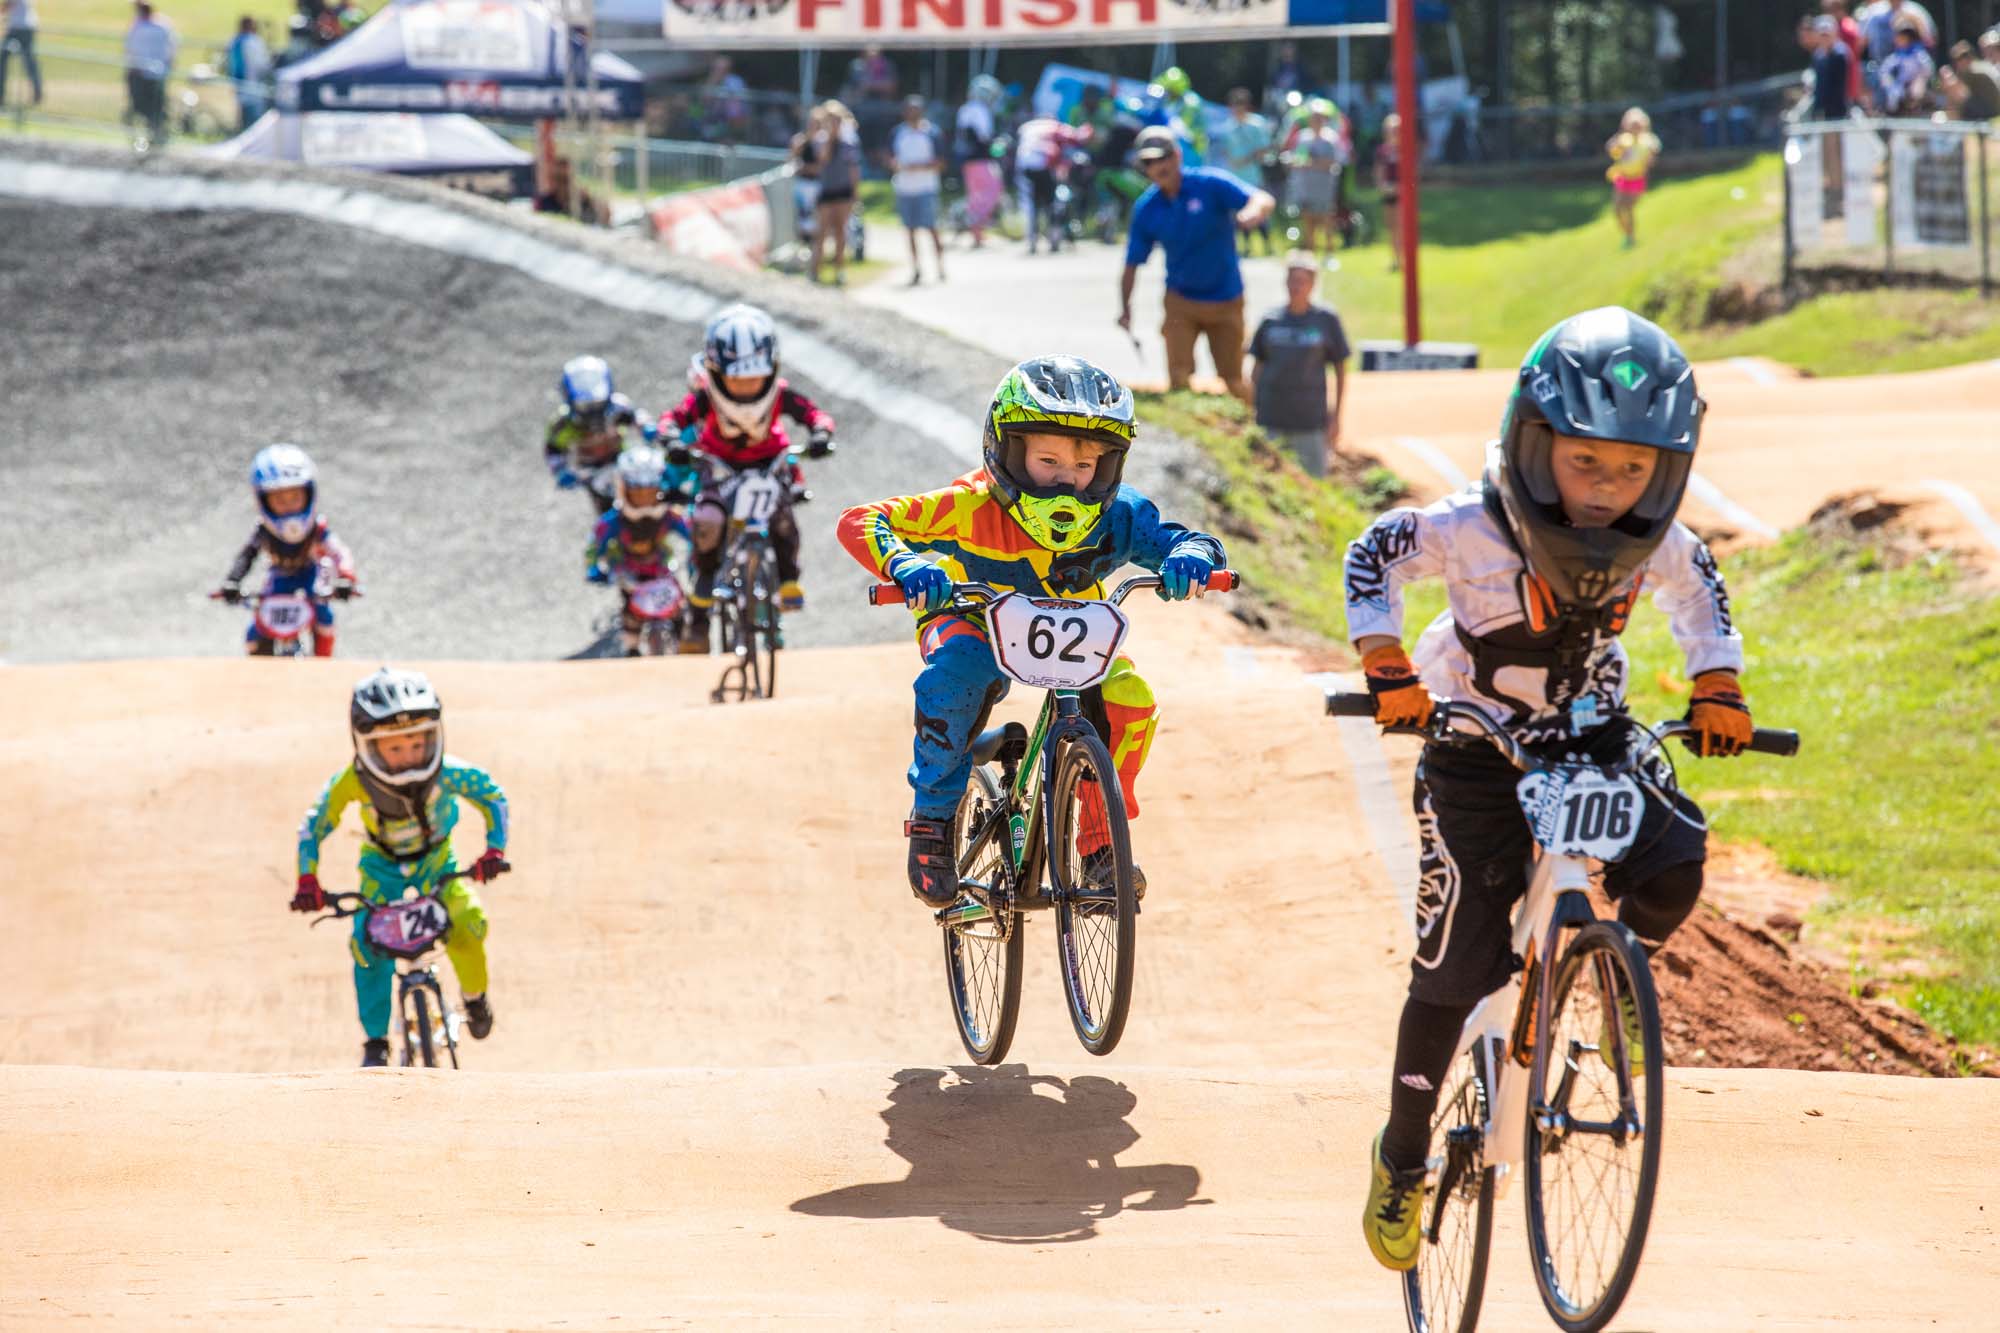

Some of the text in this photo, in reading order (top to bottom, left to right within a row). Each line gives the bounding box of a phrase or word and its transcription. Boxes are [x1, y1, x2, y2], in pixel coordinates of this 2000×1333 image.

[798, 0, 1157, 28] FINISH
[1028, 614, 1088, 663] 62
[1563, 791, 1633, 843] 106
[405, 904, 439, 941] 24
